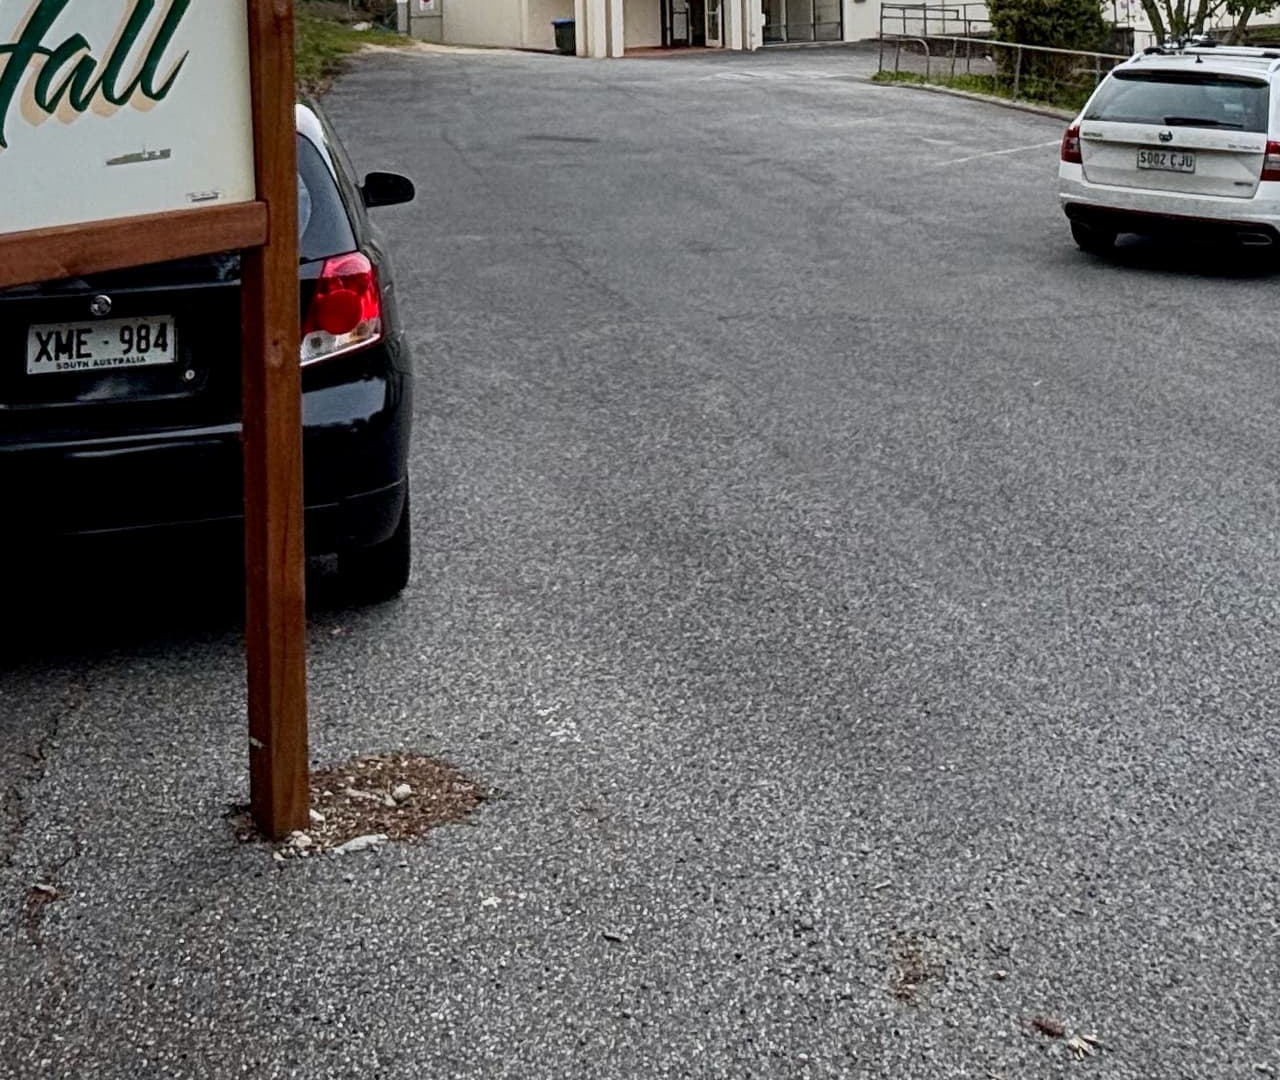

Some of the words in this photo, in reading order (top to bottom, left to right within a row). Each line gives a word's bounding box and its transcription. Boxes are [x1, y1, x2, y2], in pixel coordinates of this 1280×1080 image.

[34, 328, 93, 362] XME
[120, 323, 168, 355] 984
[56, 360, 90, 370] SOUTH
[93, 356, 146, 367] AUSTRALIA
